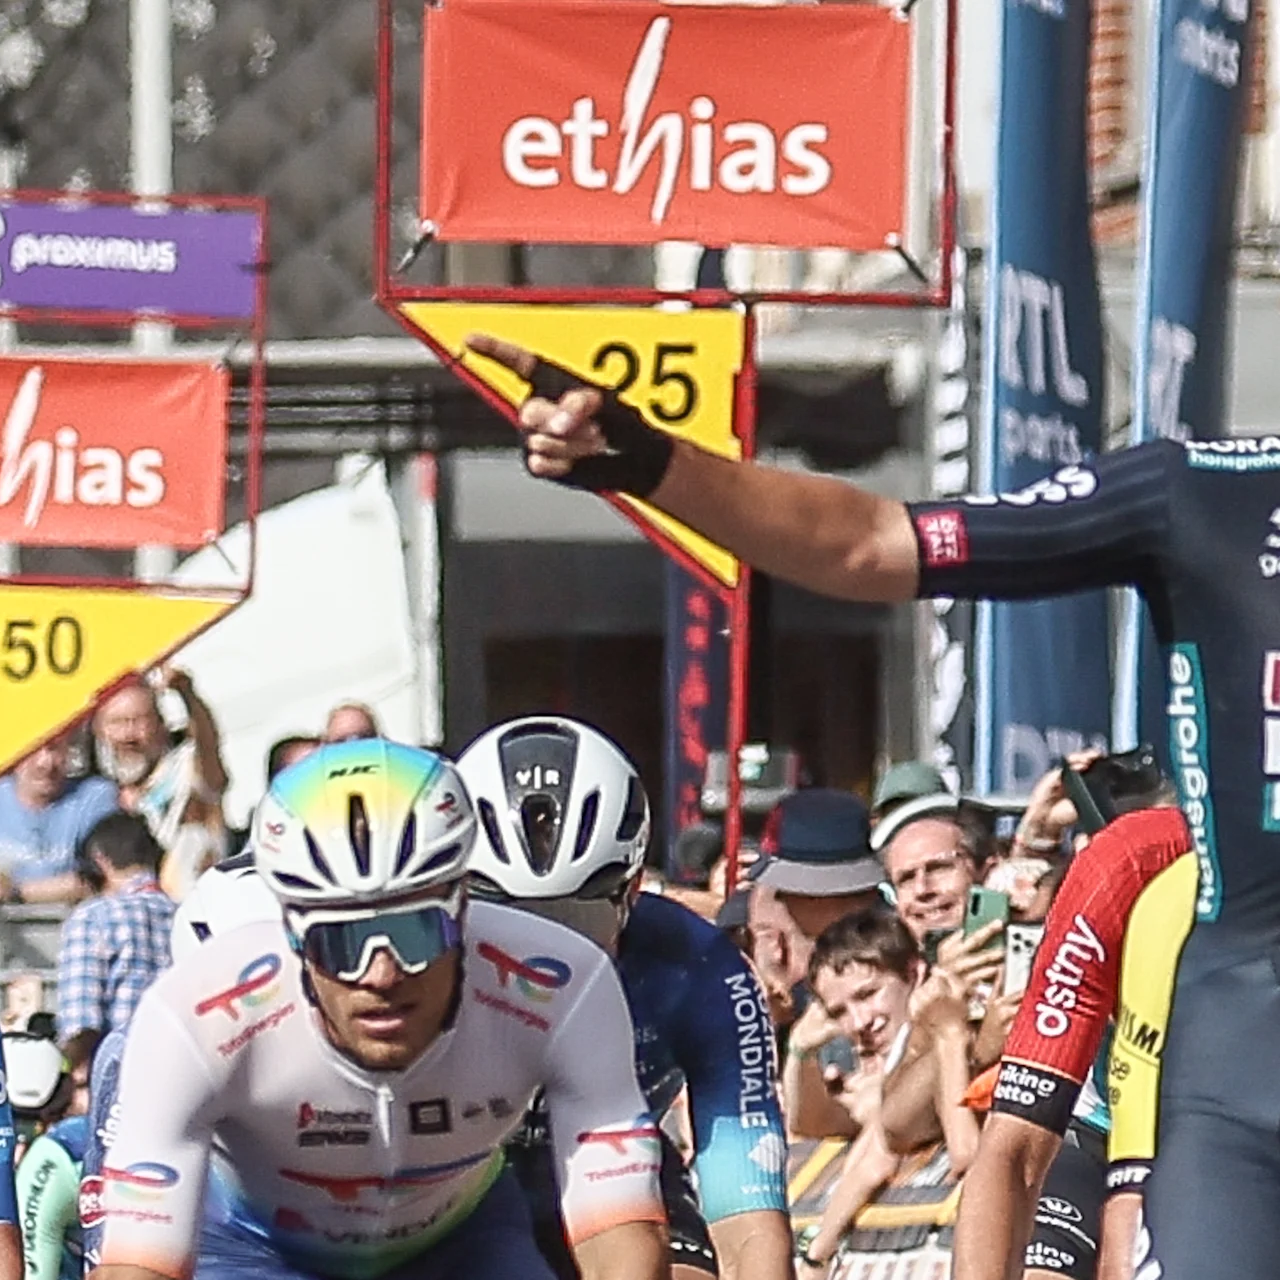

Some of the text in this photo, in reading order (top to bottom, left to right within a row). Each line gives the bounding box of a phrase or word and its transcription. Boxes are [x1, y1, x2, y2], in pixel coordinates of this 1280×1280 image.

[502, 15, 832, 224] ethias
[10, 233, 178, 273] proximus
[592, 342, 700, 422] 25
[2, 617, 82, 681] 50
[1166, 651, 1216, 915] hansgrohe
[1035, 912, 1107, 1038] dstny
[724, 971, 770, 1129] MONDIALE
